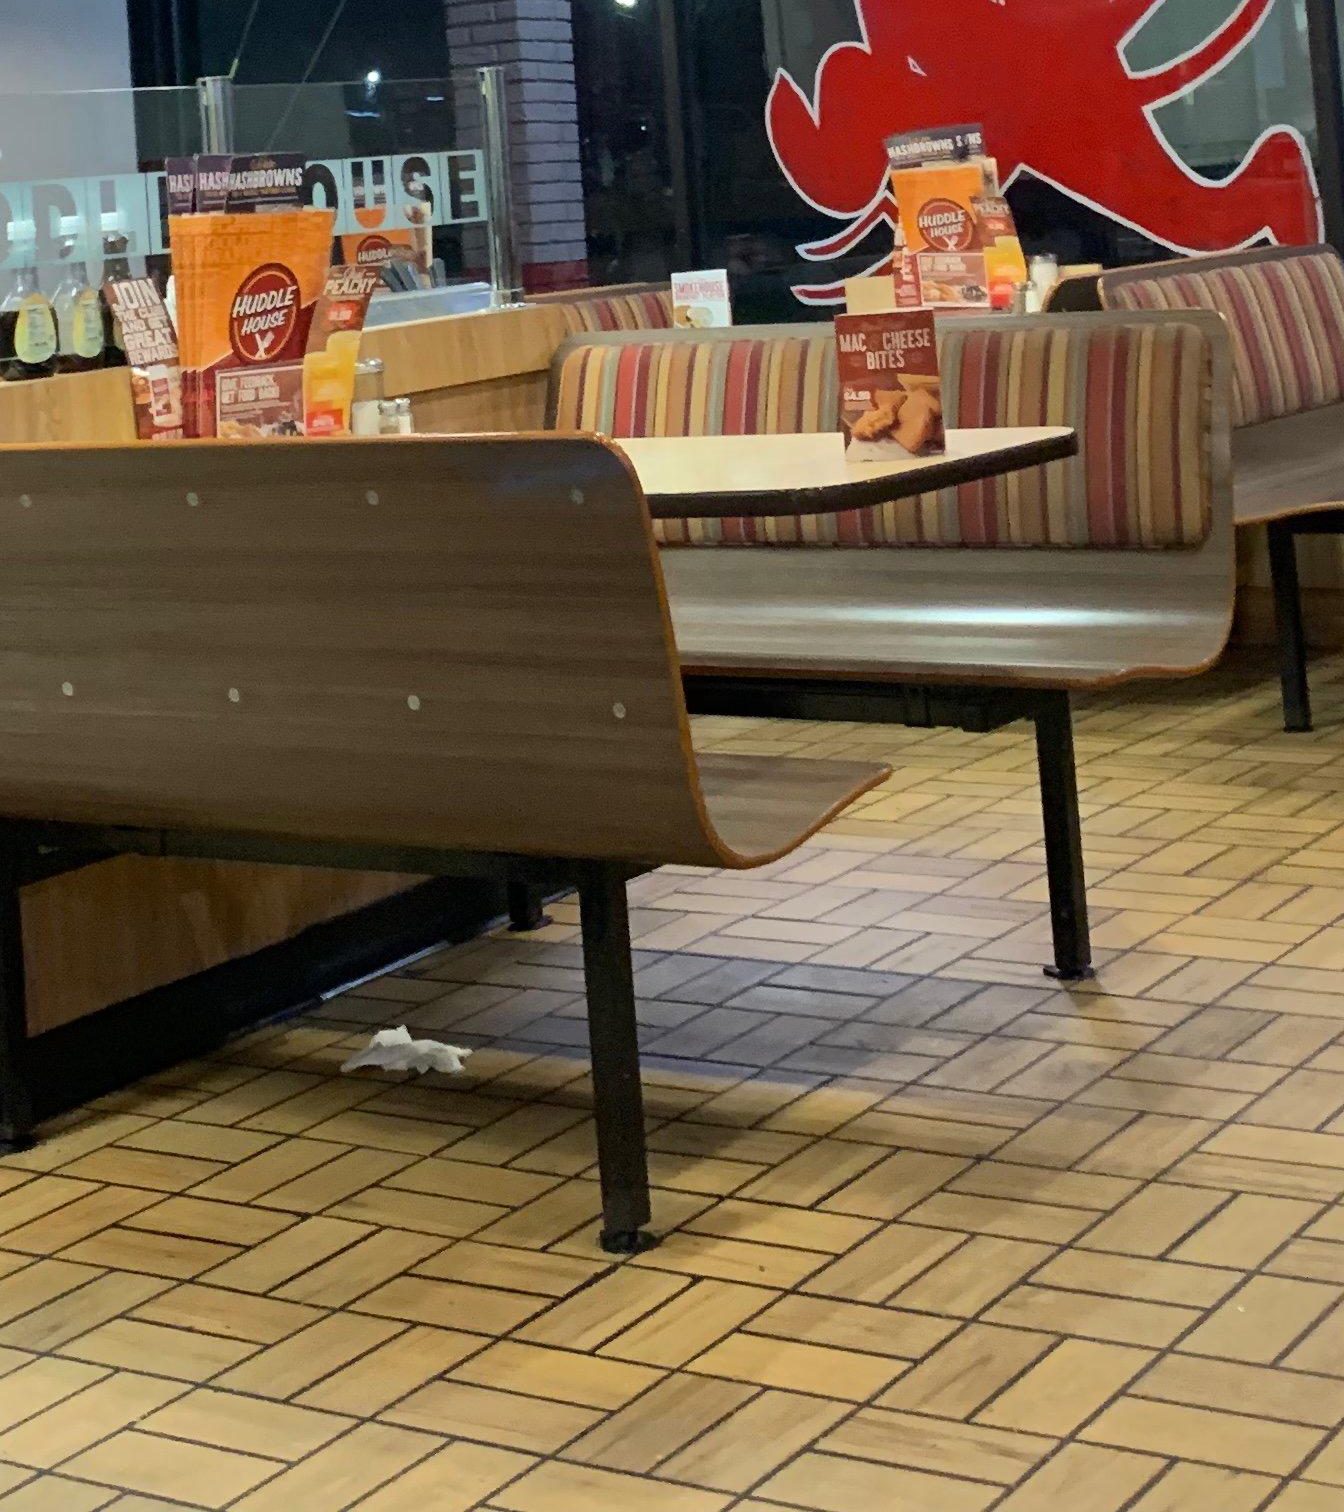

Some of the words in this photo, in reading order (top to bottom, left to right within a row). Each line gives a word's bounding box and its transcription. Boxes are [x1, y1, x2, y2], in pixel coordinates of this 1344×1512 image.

[919, 210, 965, 228] HUDDLE
[930, 223, 963, 238] HOUSE
[111, 278, 161, 310] JOIN
[232, 285, 297, 318] HUDDLE
[240, 309, 289, 337] HOUSE
[123, 328, 173, 351] GREAT
[840, 333, 867, 353] MAC
[882, 328, 931, 350] CHEESE
[866, 349, 905, 370] BITES
